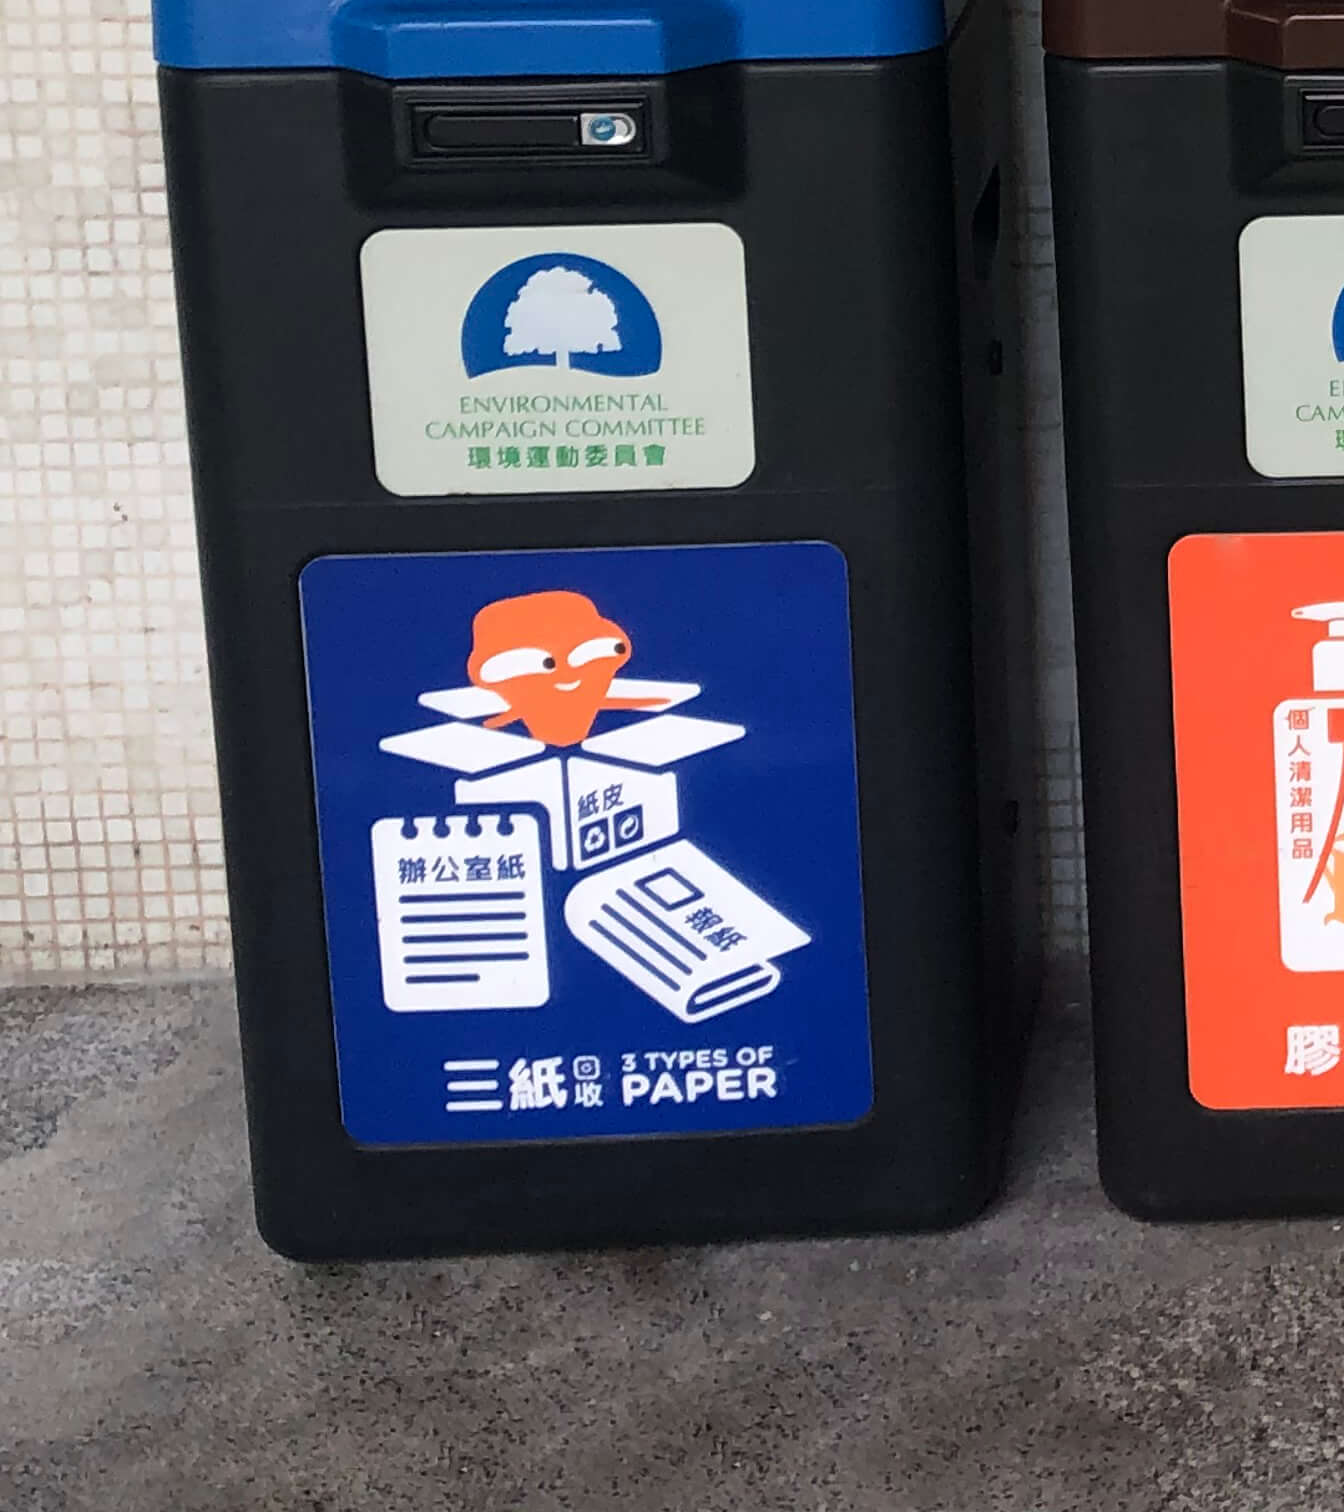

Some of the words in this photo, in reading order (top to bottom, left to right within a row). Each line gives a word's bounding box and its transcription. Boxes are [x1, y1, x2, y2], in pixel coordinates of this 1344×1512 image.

[459, 393, 668, 414] ENVIRONMENTAL
[424, 420, 557, 439] CAMPAIGN
[564, 418, 705, 437] COMMITTEE
[467, 444, 667, 469] 環境運動委員會
[1286, 708, 1313, 859] 個人清潔用品
[577, 784, 624, 821] 紙皮
[398, 855, 526, 884] 辦公室紙
[685, 907, 747, 952] 報紙
[622, 1053, 636, 1072] 3
[644, 1049, 729, 1071] TYPES
[736, 1046, 774, 1066] OF
[443, 1056, 567, 1112] 三紙
[621, 1068, 778, 1106] PAPER
